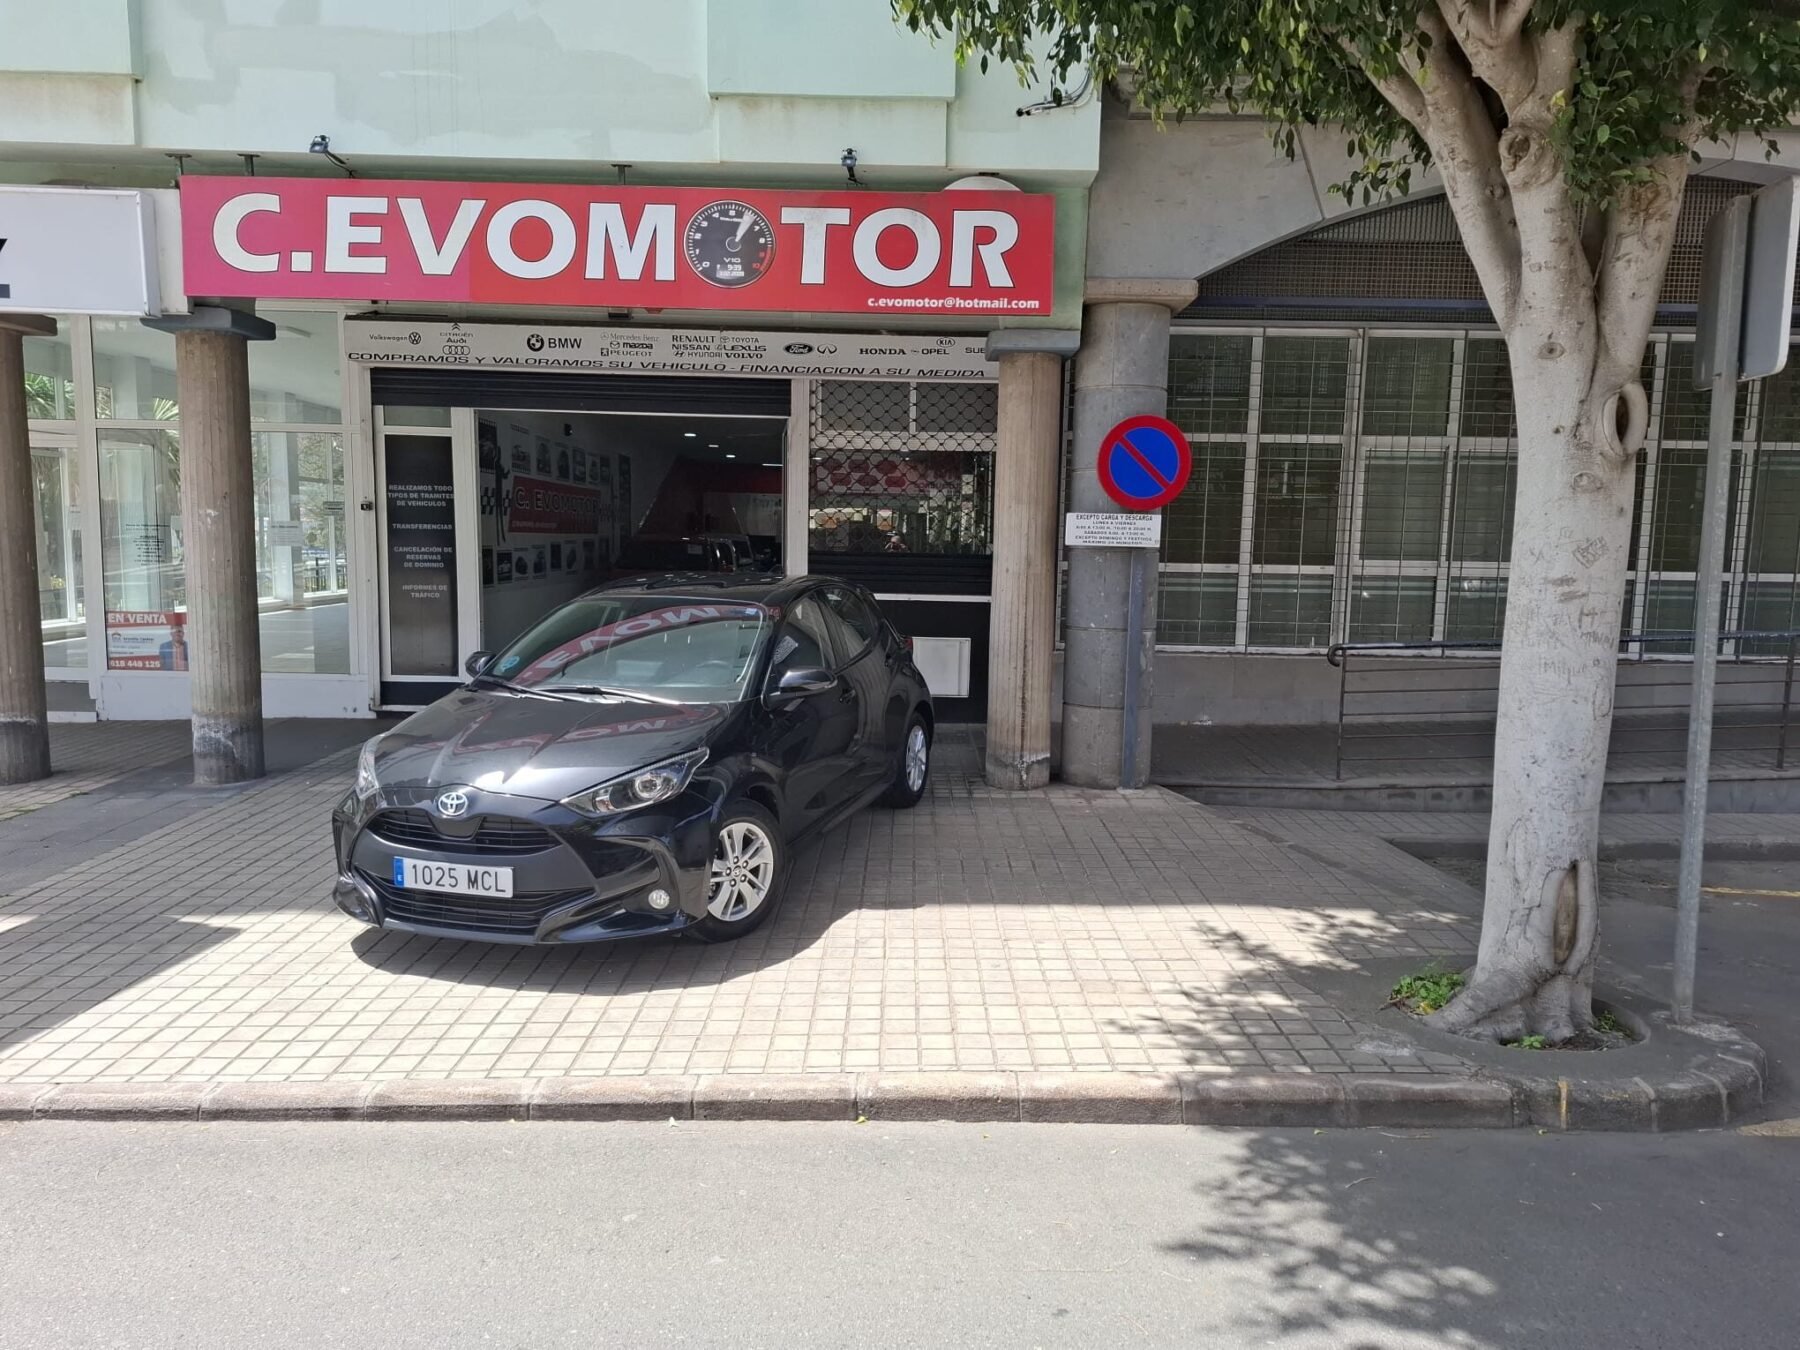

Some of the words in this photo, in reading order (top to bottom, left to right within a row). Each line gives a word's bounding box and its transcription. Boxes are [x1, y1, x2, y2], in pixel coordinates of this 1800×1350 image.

[867, 297, 1040, 309] c.evomotor@hotmail.com
[369, 333, 408, 343] Volkswagen
[446, 336, 467, 344] Audi
[671, 334, 717, 344] RENAULT
[731, 336, 760, 344] TOYOTA
[547, 337, 582, 349] BMW
[671, 343, 711, 351] NISSAN
[723, 344, 767, 352] LEXUS
[859, 347, 908, 356] HONDA
[921, 347, 950, 355] OPEL
[348, 352, 469, 364] COMPRAMOS
[475, 356, 486, 364] Y
[492, 357, 603, 368] VALORAMOS
[608, 360, 633, 368] SU
[640, 360, 726, 372] VEHICULO
[739, 364, 866, 375] FINANCIACION
[868, 367, 881, 375] A
[885, 367, 911, 376] SU
[916, 369, 985, 377] MEDIDA
[388, 484, 433, 492] REALIZAMOS
[1076, 513, 1100, 521] EXCEPTO
[107, 612, 125, 623] EN
[127, 613, 167, 624] VENTA
[412, 863, 459, 888] 1025
[467, 868, 506, 893] MCL
